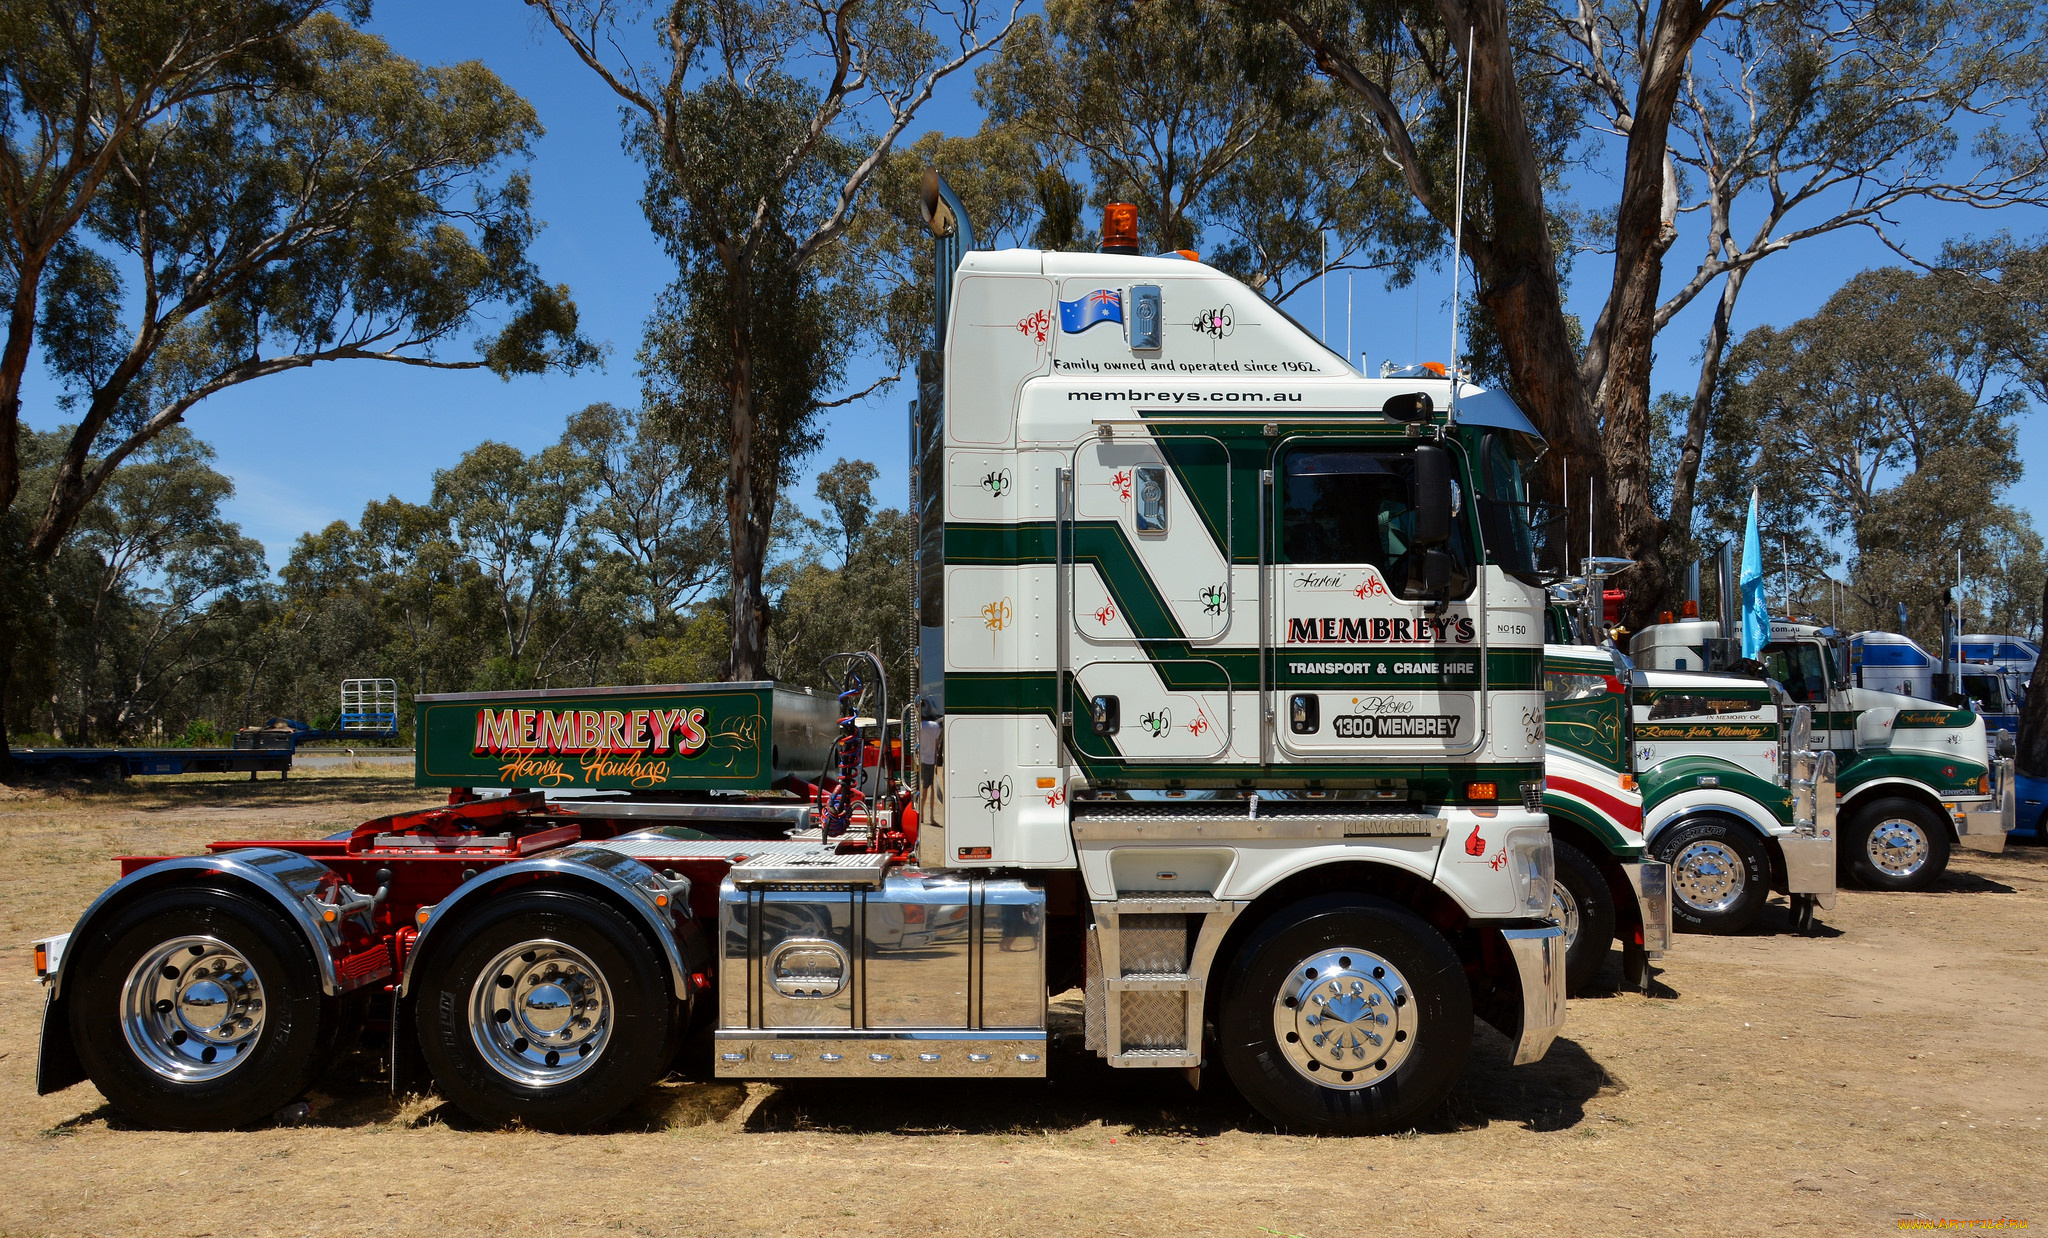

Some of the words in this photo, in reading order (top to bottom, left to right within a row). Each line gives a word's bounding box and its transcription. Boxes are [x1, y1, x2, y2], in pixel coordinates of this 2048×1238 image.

[1053, 358, 1100, 373] Family
[1103, 359, 1147, 372] owned
[1150, 360, 1176, 372] and
[1179, 360, 1240, 374] operated
[1243, 360, 1279, 373] since
[1281, 361, 1321, 373] 1962.
[1067, 389, 1302, 404] membreys.com.au
[1287, 615, 1476, 643] MEMBREY'S
[1289, 662, 1370, 675] TRANSPORT
[1376, 662, 1388, 675] &
[1393, 662, 1440, 675] CRANE
[1443, 662, 1474, 675] HIRE
[1354, 695, 1414, 715] Phone
[474, 708, 708, 755] MEMBREY'S
[1335, 717, 1374, 736] 1300
[1377, 717, 1460, 736] MEMBREY
[1684, 726, 1713, 739] John
[498, 745, 575, 787] Heavy
[580, 746, 670, 787] Haulage
[1344, 821, 1431, 834] KENWORTH
